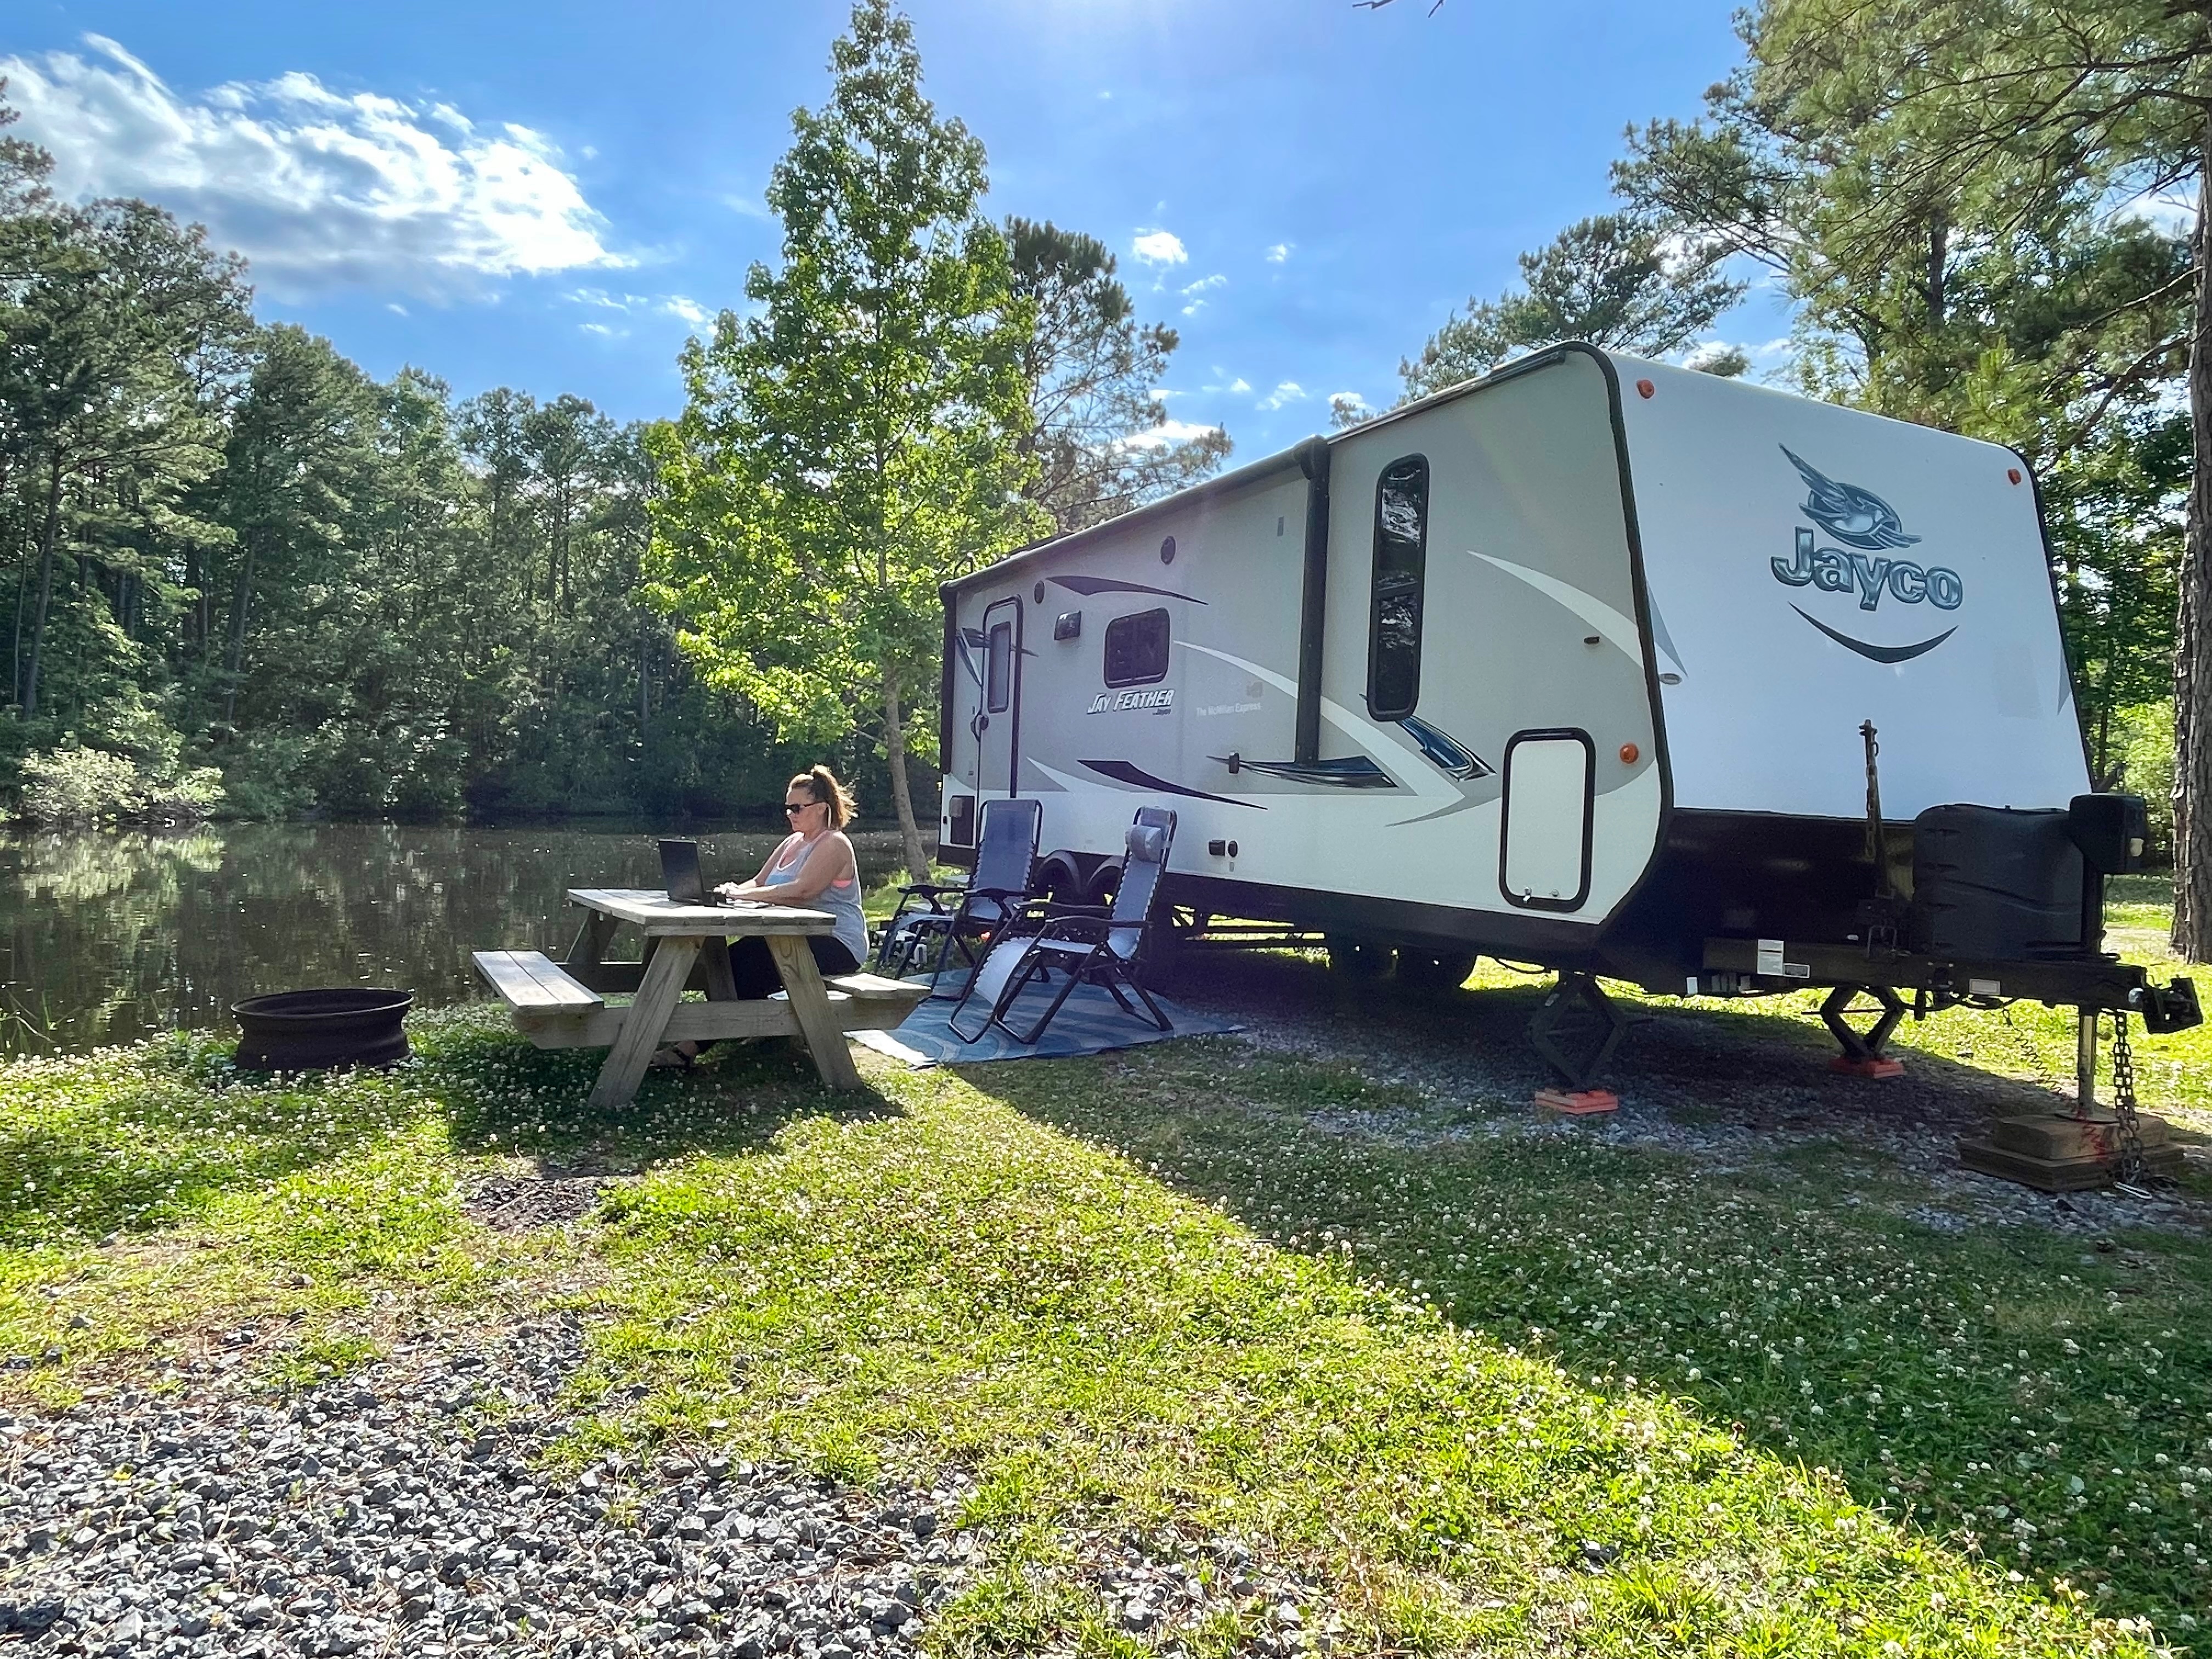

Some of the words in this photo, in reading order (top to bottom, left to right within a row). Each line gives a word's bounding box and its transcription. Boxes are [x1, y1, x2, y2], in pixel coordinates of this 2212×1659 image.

[1771, 527, 1963, 611] Jayco
[1087, 693, 1112, 714] JAY
[1113, 690, 1175, 712] FEATHER
